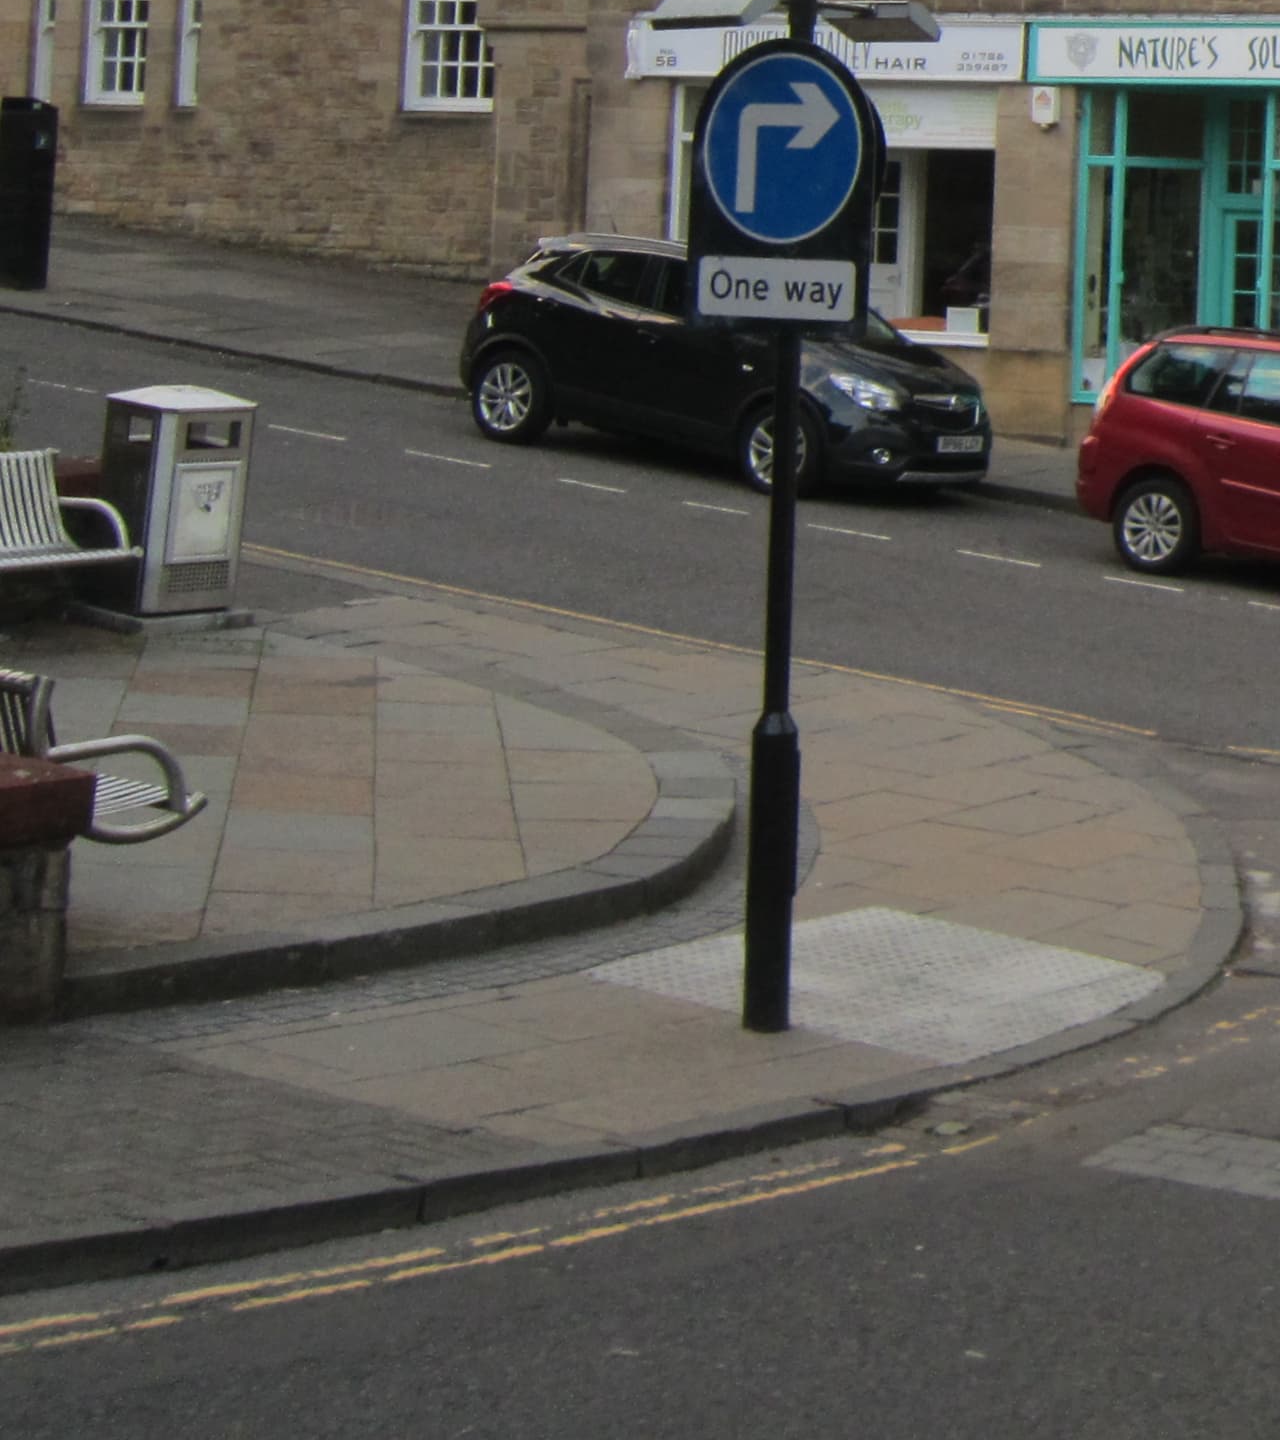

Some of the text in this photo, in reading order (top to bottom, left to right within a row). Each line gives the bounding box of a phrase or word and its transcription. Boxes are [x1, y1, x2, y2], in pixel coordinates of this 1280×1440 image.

[656, 56, 677, 67] 58
[875, 56, 927, 71] HAIR
[1118, 35, 1219, 69] NATURE'S
[710, 270, 843, 309] One way
